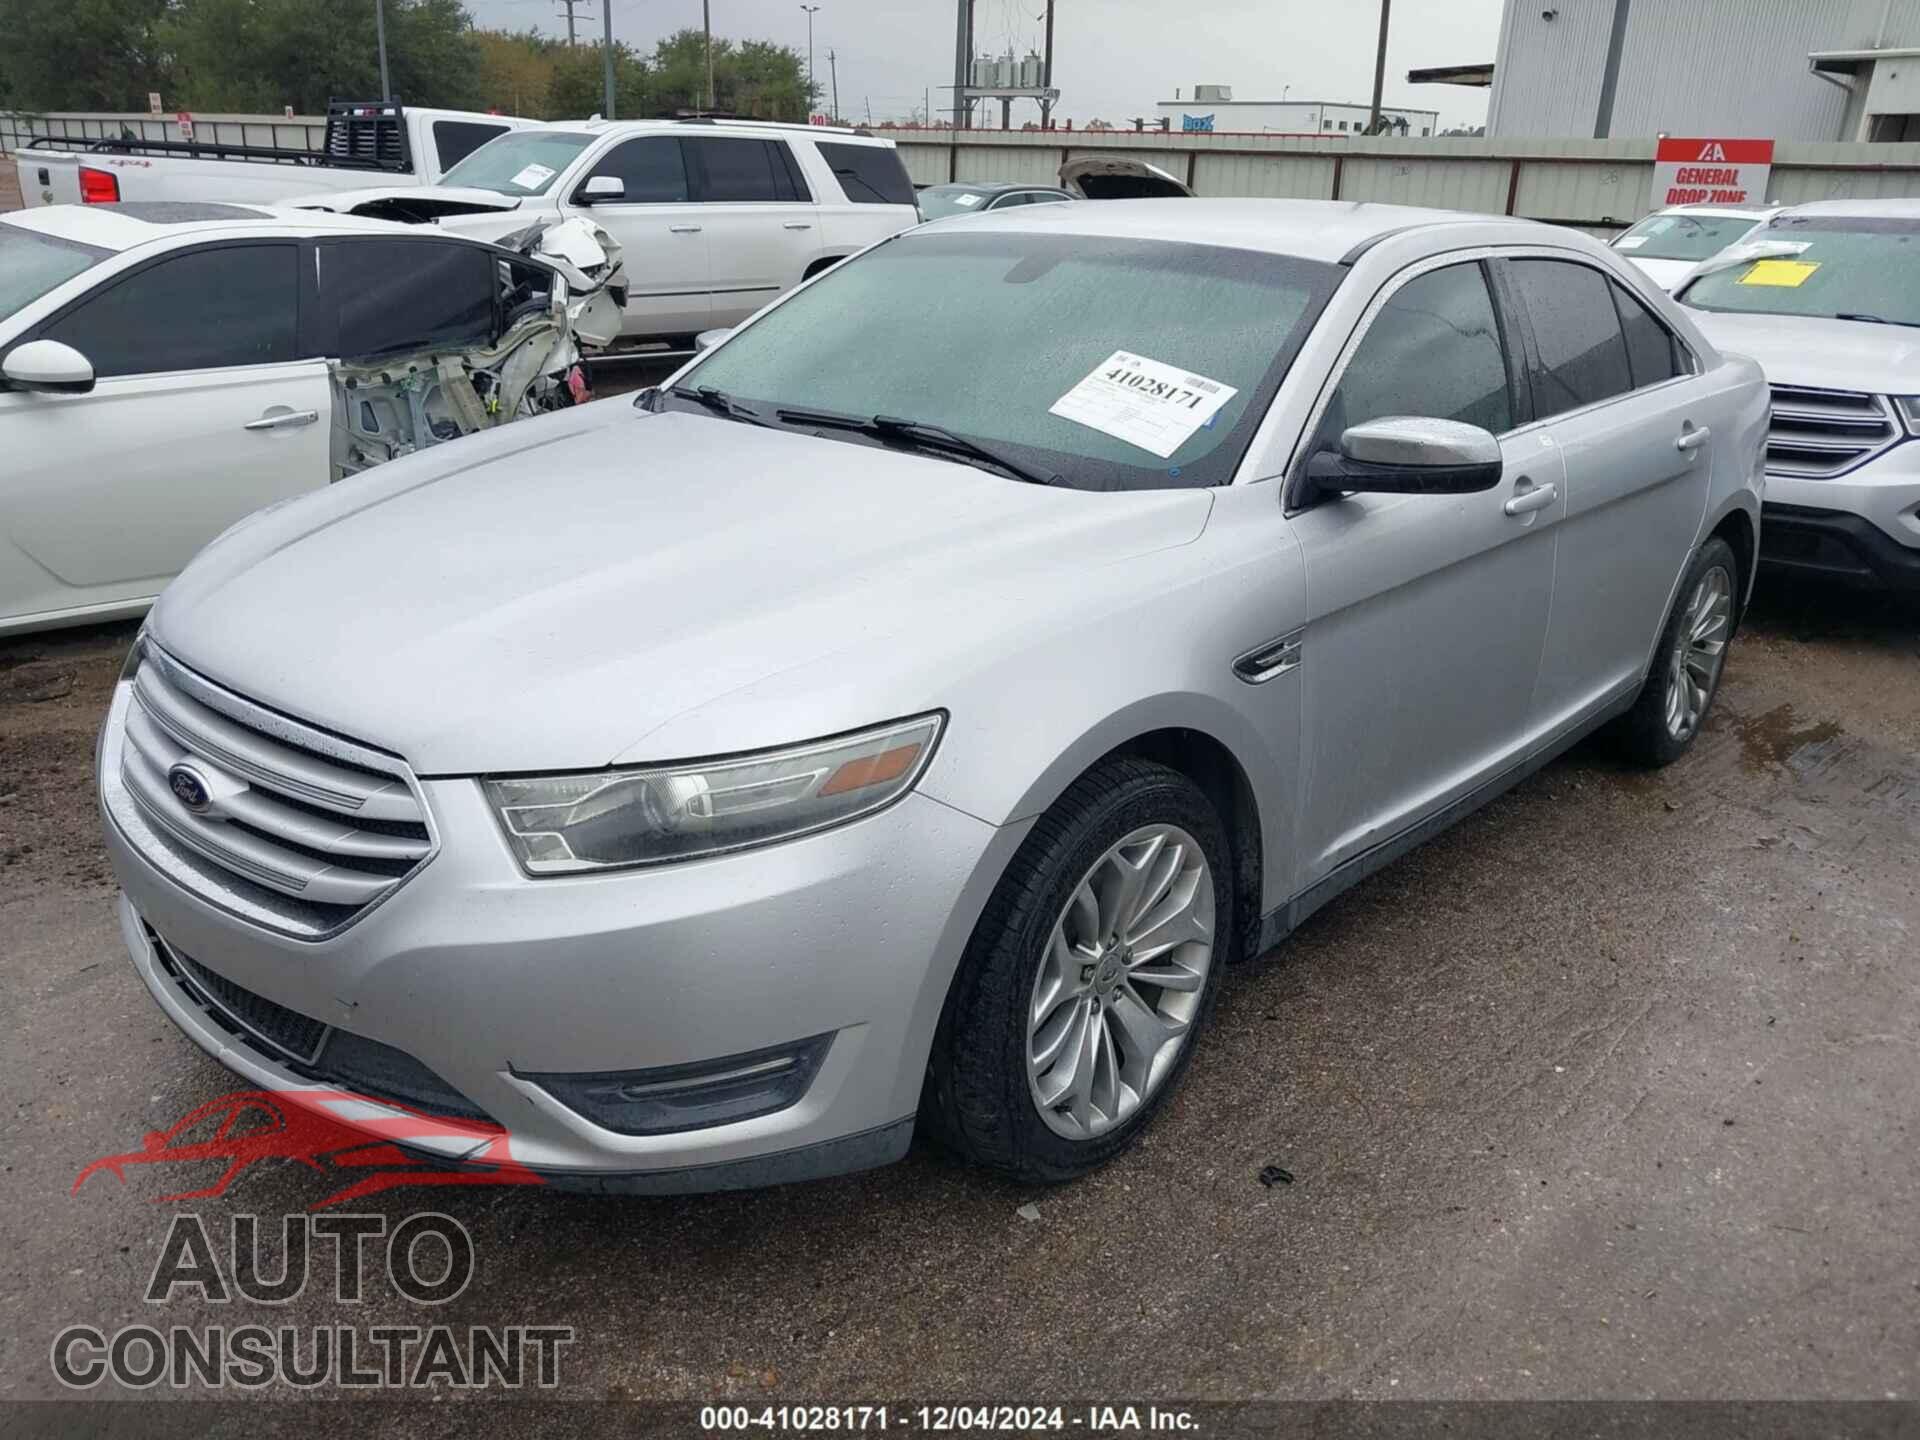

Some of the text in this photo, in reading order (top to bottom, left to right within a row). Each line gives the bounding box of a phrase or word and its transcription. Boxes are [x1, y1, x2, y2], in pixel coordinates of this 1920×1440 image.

[1676, 167, 1738, 185] GENERAL
[1665, 187, 1747, 205] DROP ZONE
[1106, 368, 1203, 409] 41028171
[175, 774, 199, 801] Ford
